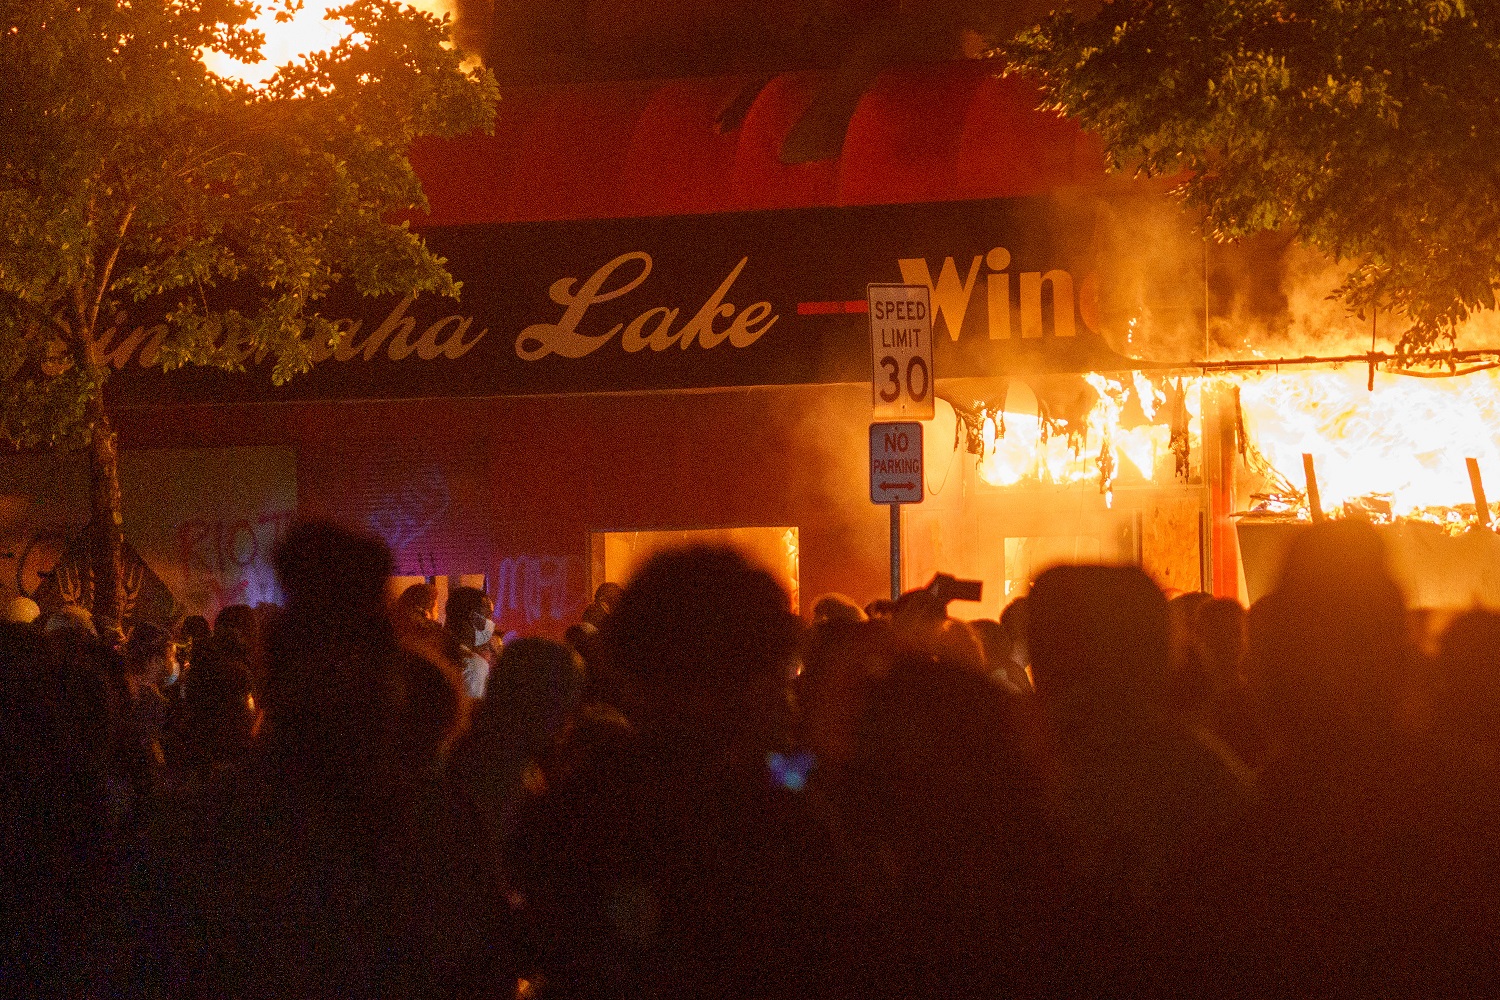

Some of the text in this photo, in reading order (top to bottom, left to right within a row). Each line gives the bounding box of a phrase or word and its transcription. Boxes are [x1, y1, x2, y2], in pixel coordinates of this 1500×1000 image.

[515, 251, 779, 361] Lake
[875, 301, 926, 320] SPEED
[881, 328, 921, 347] LIMIT
[879, 355, 928, 403] 30
[884, 433, 909, 453] NO
[874, 459, 920, 474] PARKING
